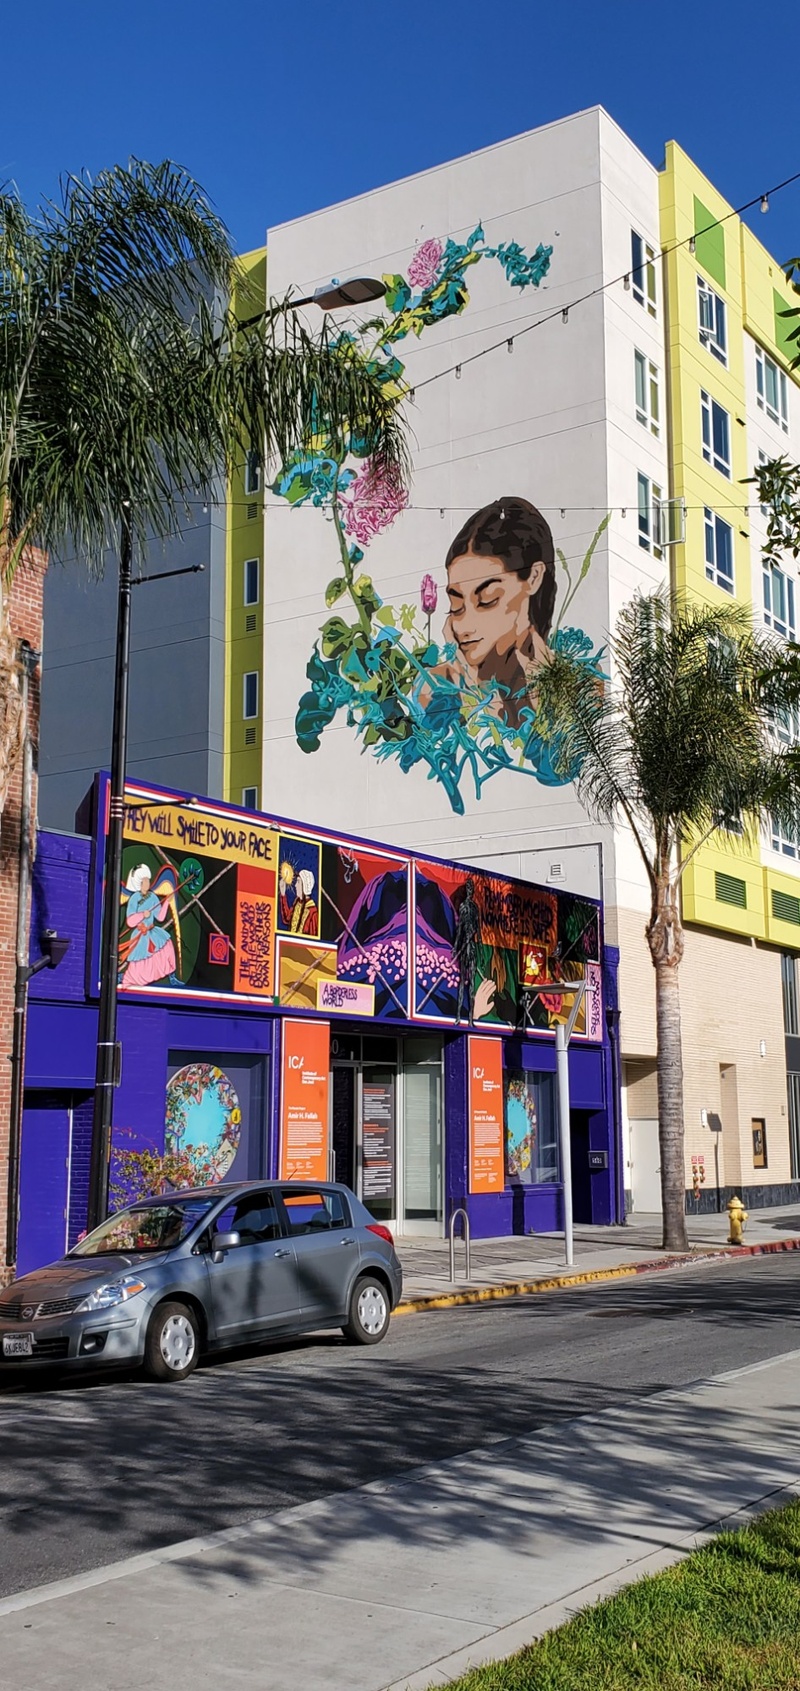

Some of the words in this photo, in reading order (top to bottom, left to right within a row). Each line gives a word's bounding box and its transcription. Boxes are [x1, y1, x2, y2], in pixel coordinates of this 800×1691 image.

[205, 821, 219, 846] TO
[220, 827, 247, 852] YOUR
[248, 831, 272, 861] FACE
[247, 904, 255, 943] WORLD
[262, 902, 272, 956] REASONS
[519, 917, 529, 936] IS
[239, 956, 250, 983] THE
[262, 960, 270, 988] OWN
[321, 993, 344, 1007] WORLD
[323, 983, 329, 995] A
[329, 985, 358, 1000] BORDERLESS
